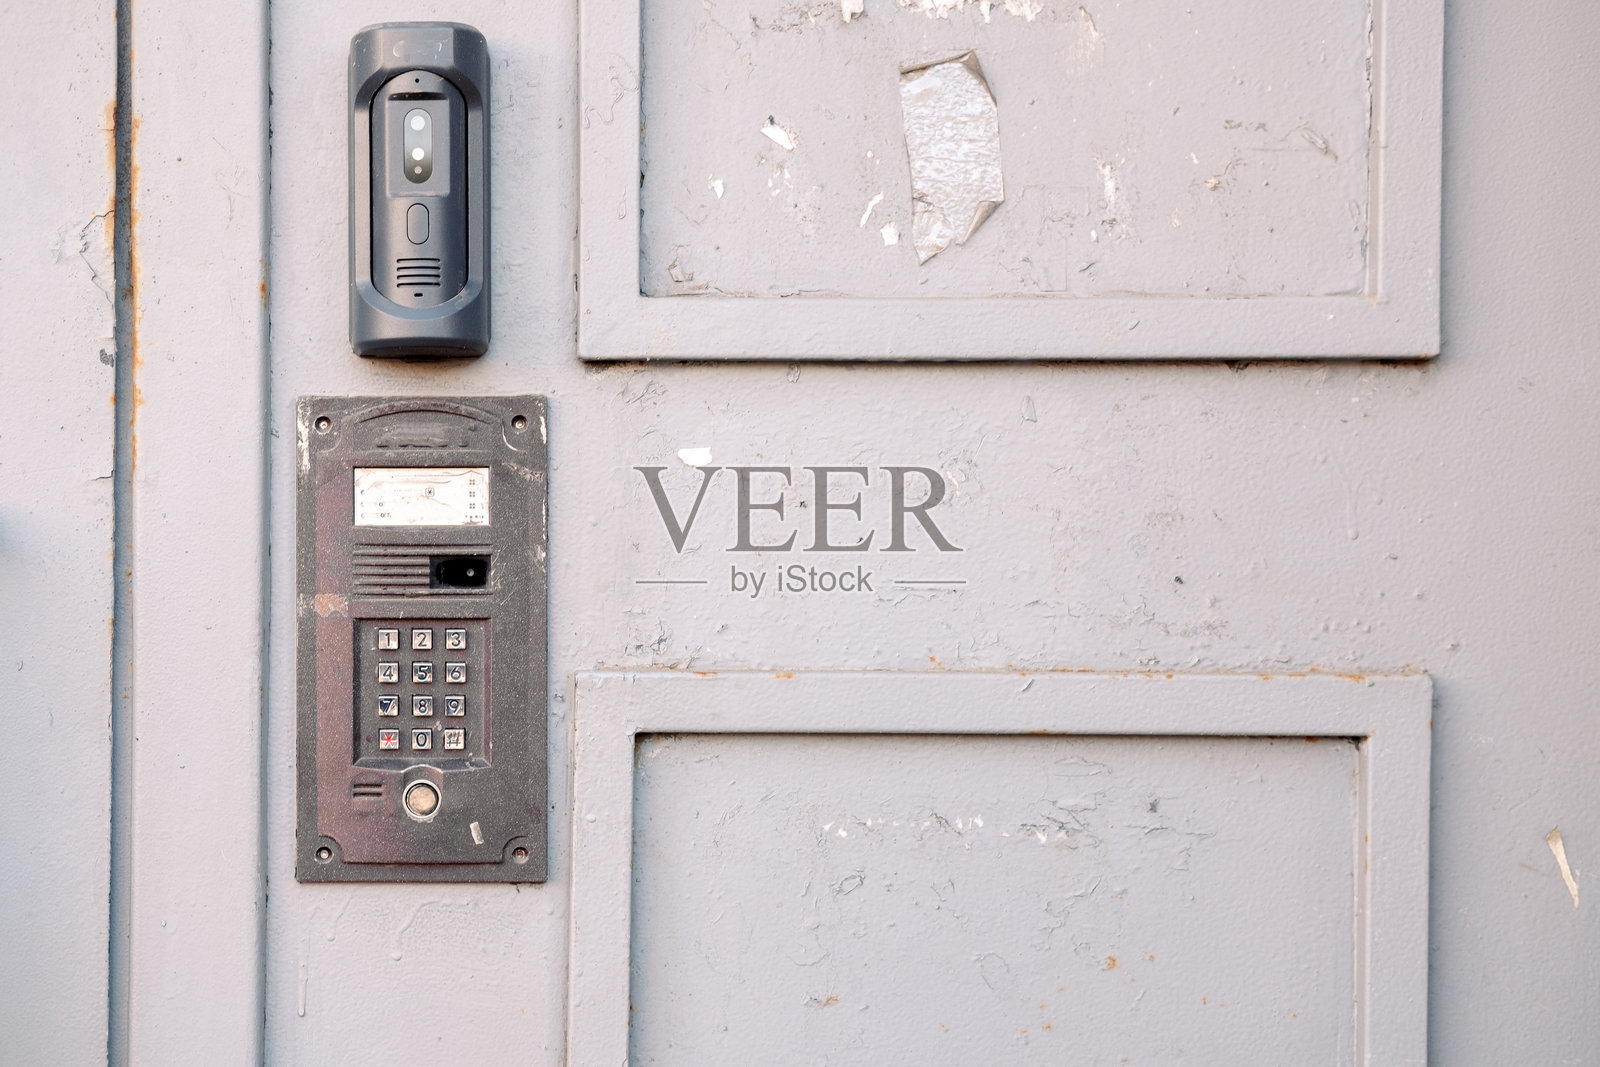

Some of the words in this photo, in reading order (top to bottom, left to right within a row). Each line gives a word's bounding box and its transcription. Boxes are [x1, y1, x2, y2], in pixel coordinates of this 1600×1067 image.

[416, 632, 427, 647] 2
[451, 632, 461, 647] 3
[382, 665, 394, 681] 4
[417, 665, 428, 681] 5
[450, 665, 461, 681] 6
[382, 698, 395, 715] 7
[418, 698, 428, 714] 8
[448, 698, 461, 715] 9
[416, 732, 427, 748] 0
